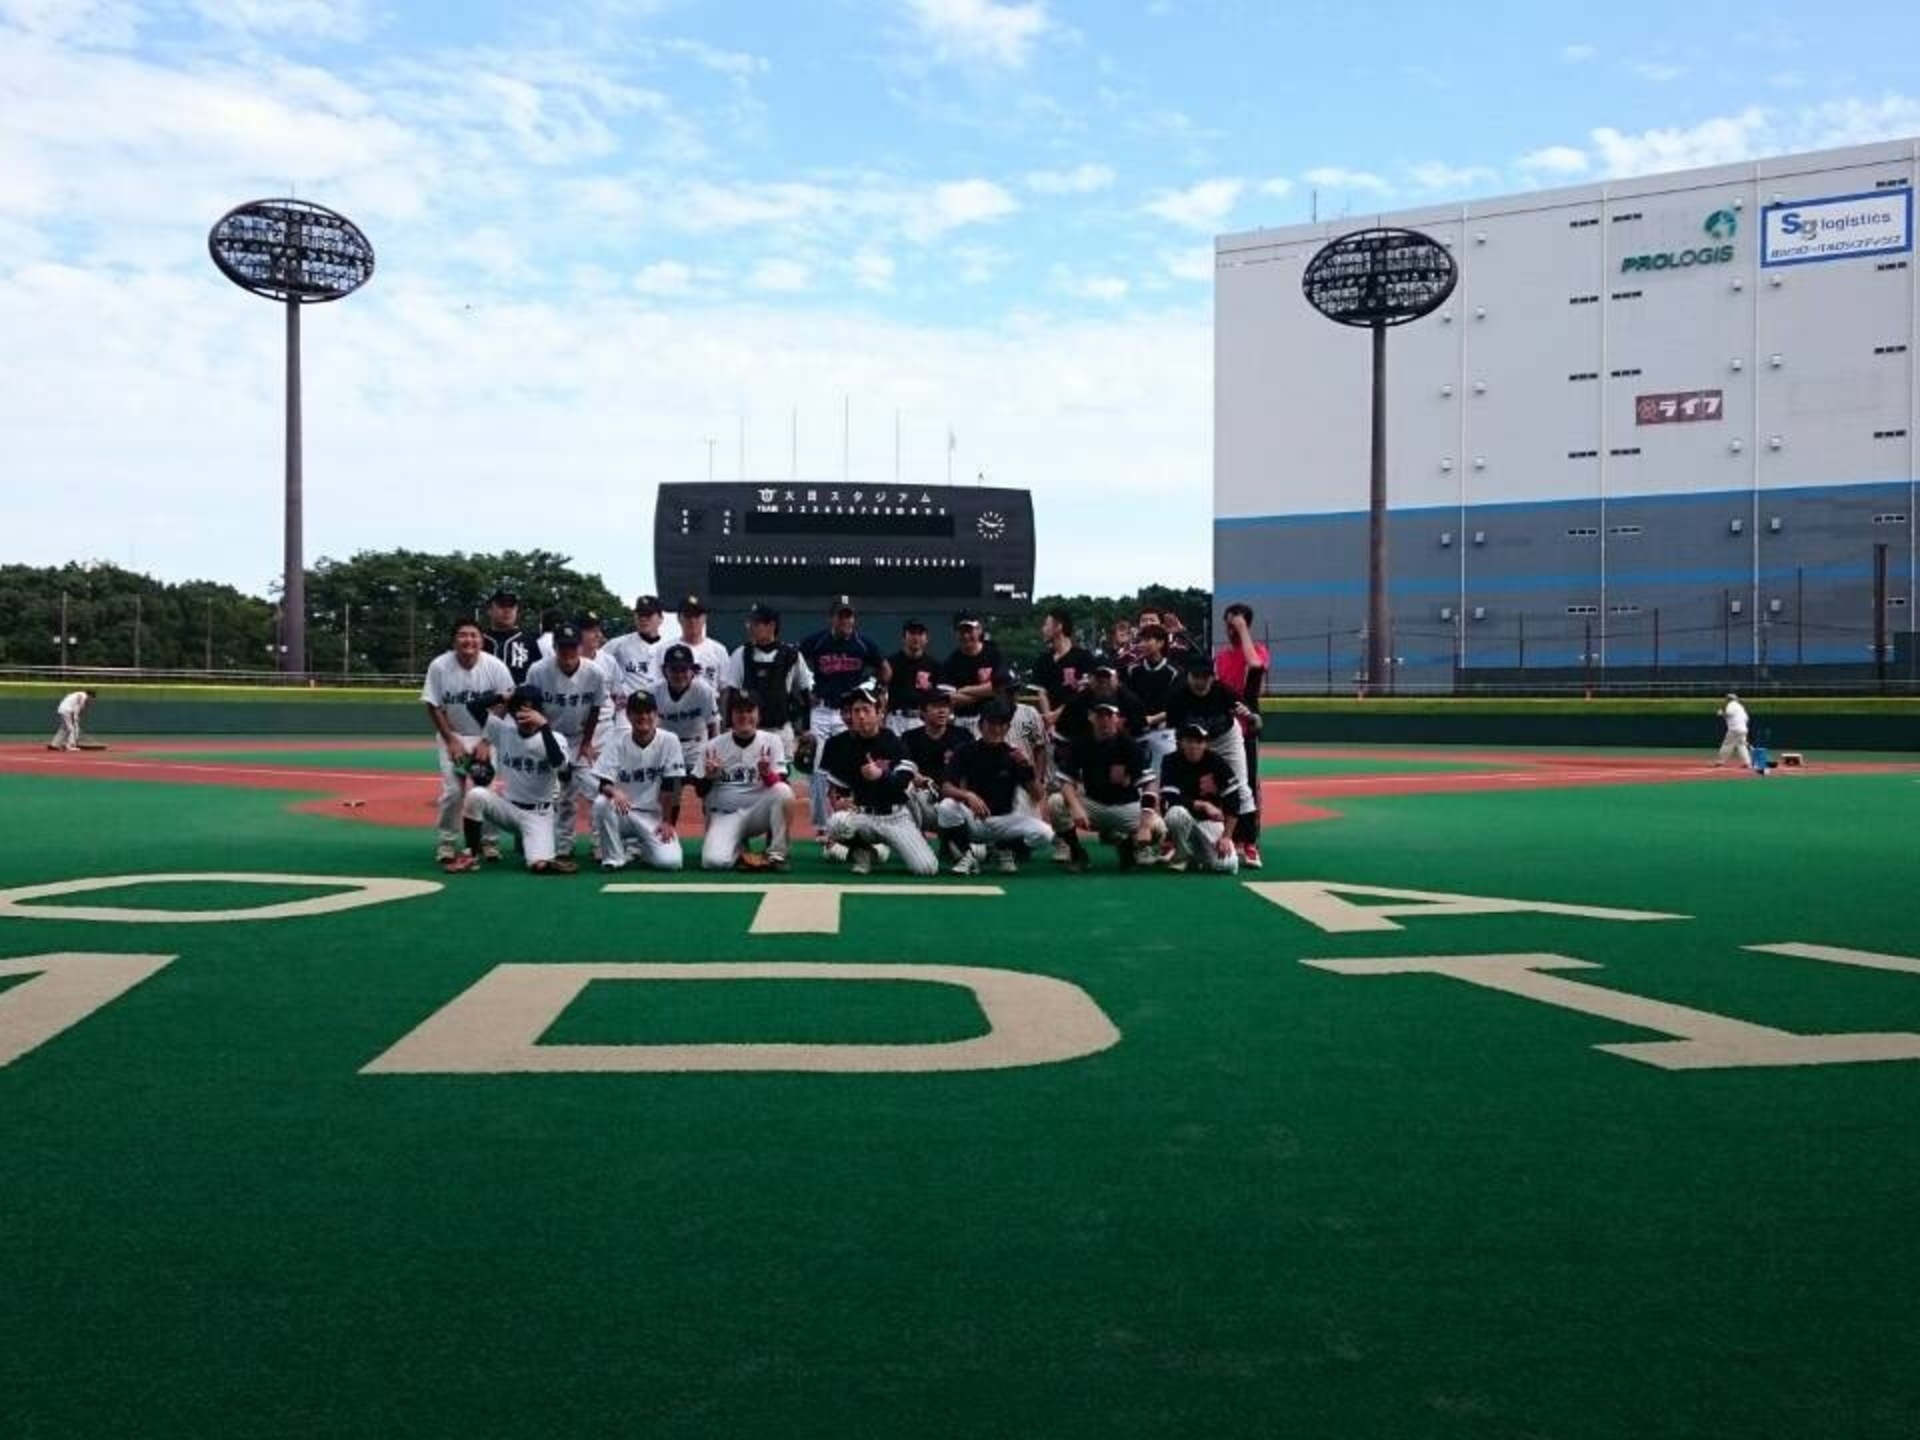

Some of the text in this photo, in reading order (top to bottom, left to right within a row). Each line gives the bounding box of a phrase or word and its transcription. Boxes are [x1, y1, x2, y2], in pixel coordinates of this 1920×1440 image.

[1821, 213, 1891, 231] logistics
[1621, 244, 1734, 273] PROLOGIS
[1659, 396, 1721, 417] ライフ
